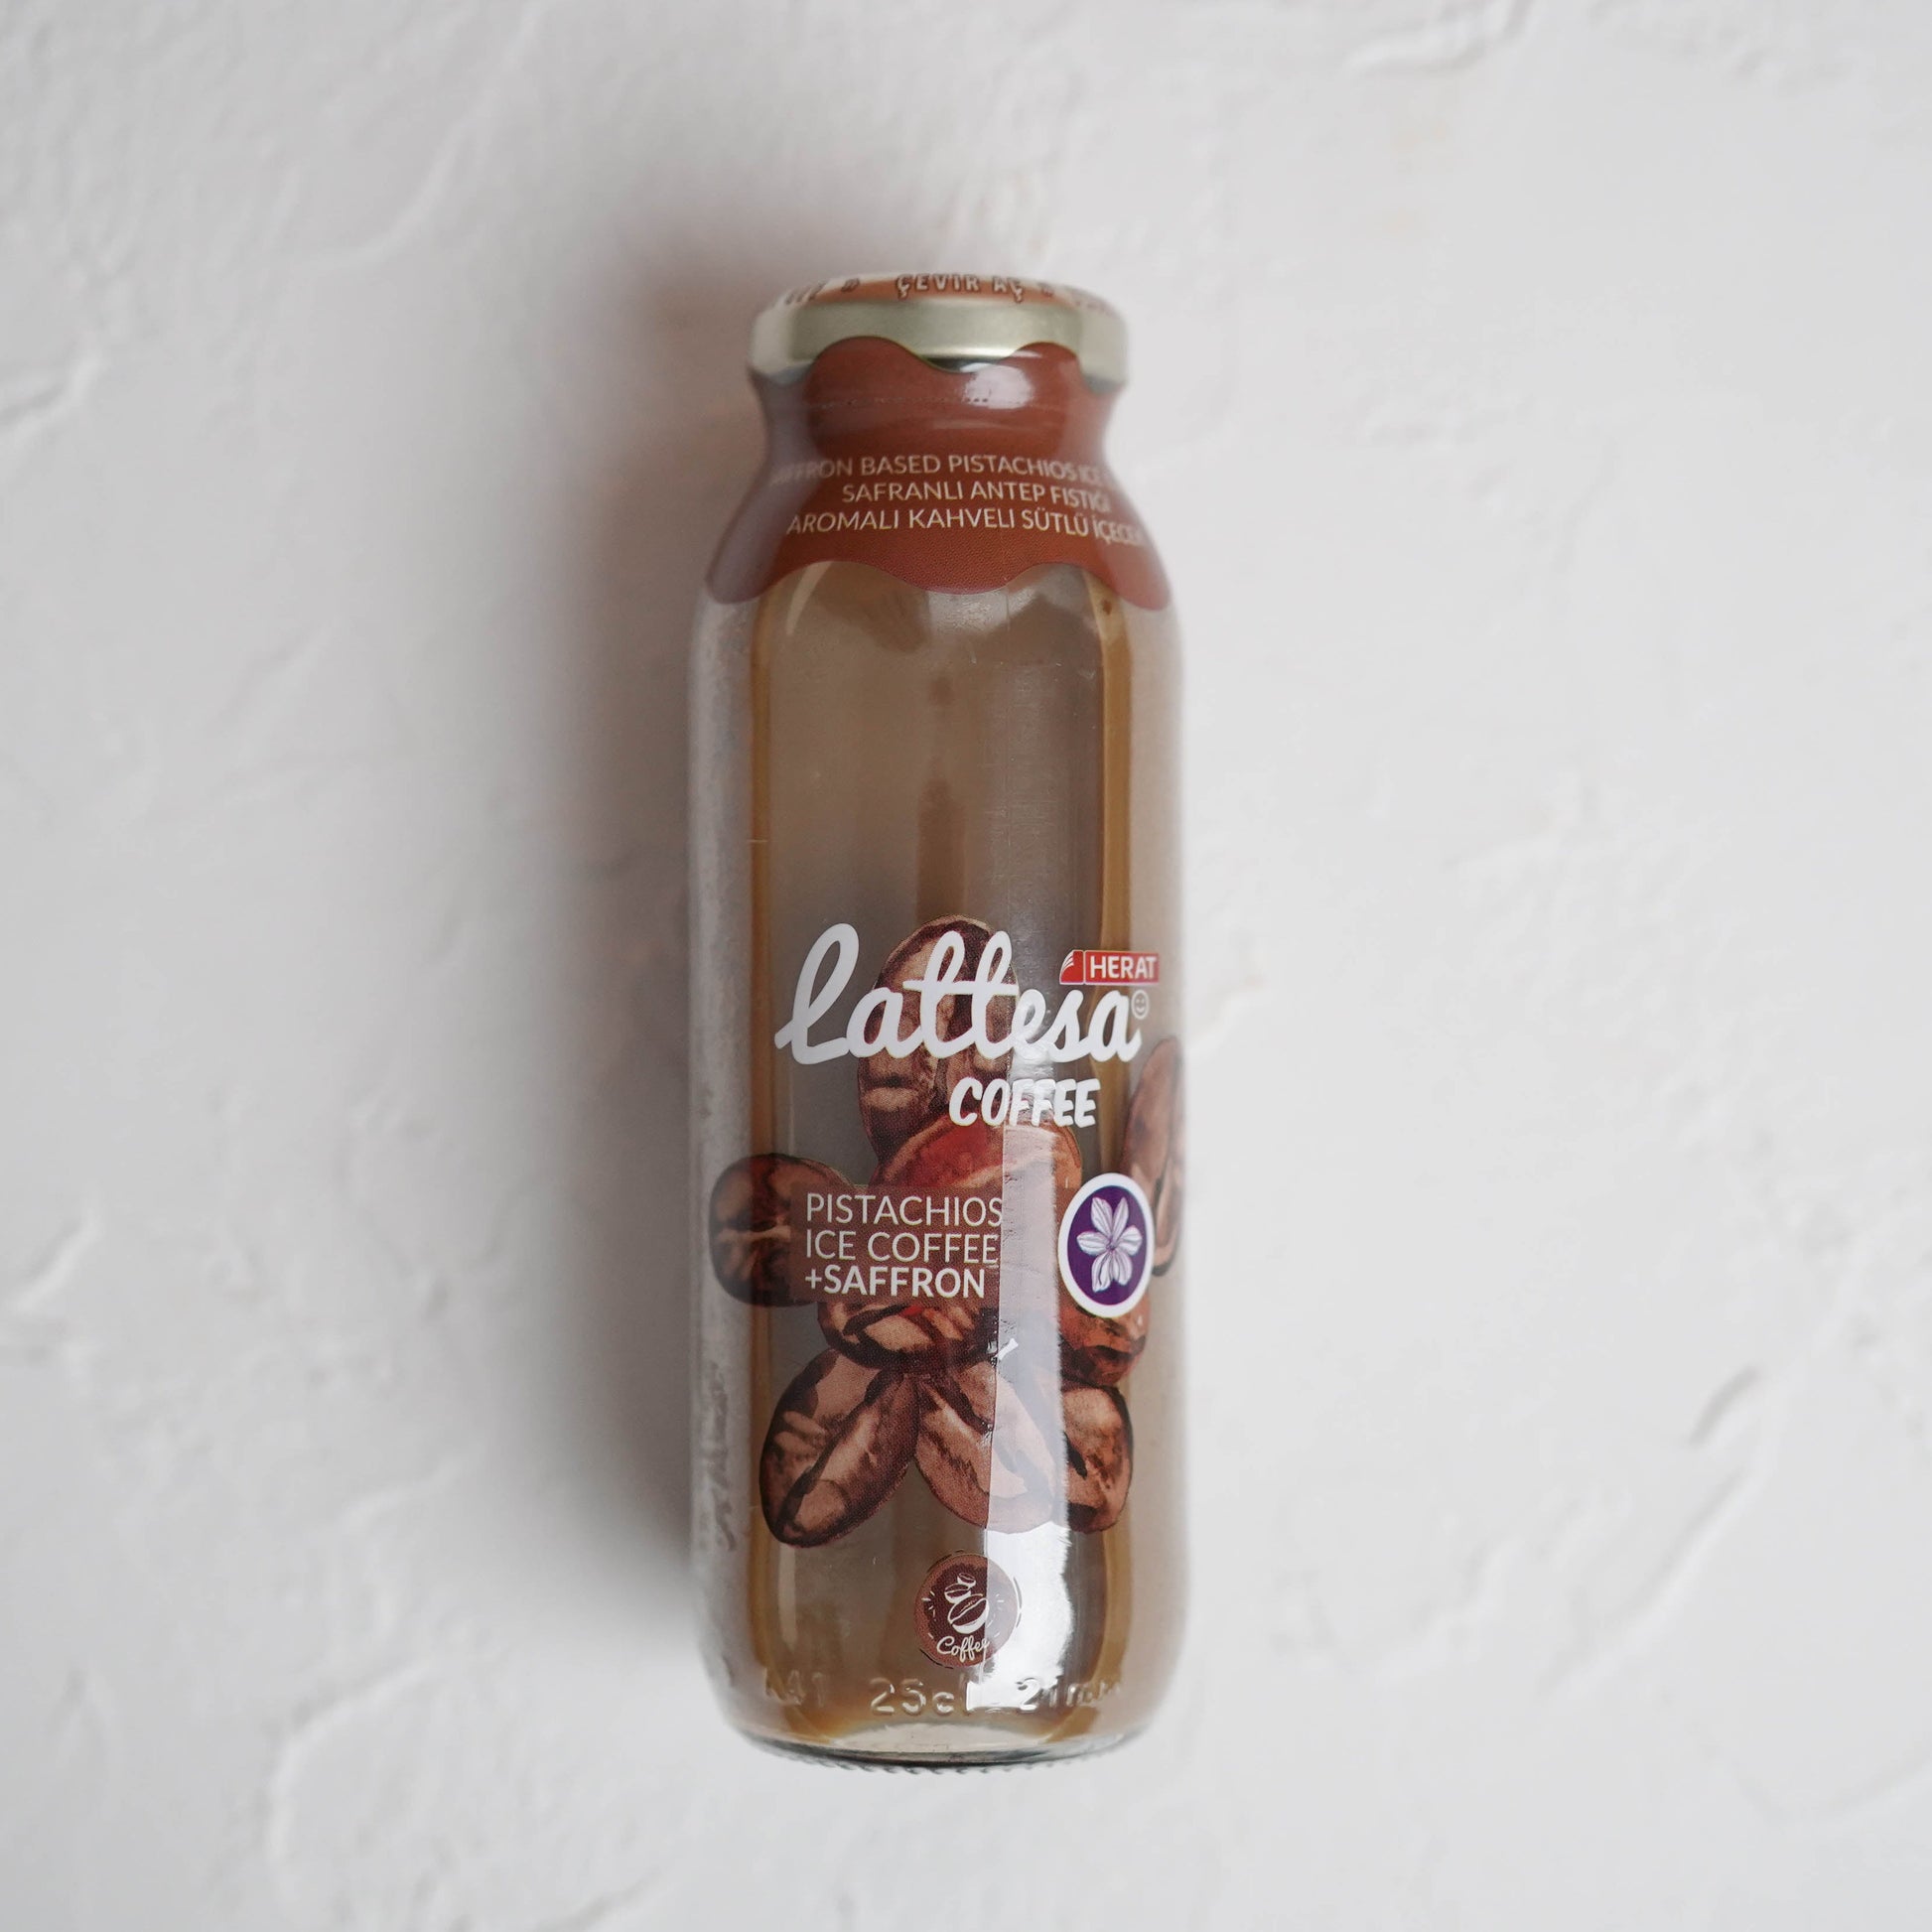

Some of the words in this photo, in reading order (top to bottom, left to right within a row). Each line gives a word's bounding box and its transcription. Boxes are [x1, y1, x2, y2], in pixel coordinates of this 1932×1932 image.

[861, 455, 940, 476] BASED
[949, 454, 1077, 482] PISTACHIOS
[842, 482, 963, 502] SAFRANLI
[970, 482, 1045, 502] ANTEP
[785, 509, 899, 534] AROMALI
[908, 507, 1016, 529] KAHVELI
[1021, 506, 1089, 537] SÜTLÜ
[1090, 955, 1157, 979] HERAT
[948, 1076, 1100, 1128] COFFEE
[806, 1192, 1004, 1228] PISTACHIOS
[806, 1229, 857, 1261] ICE
[867, 1231, 1000, 1264] COFFEE
[804, 1264, 986, 1300] +SAFFRON
[936, 1635, 991, 1663] Coffee
